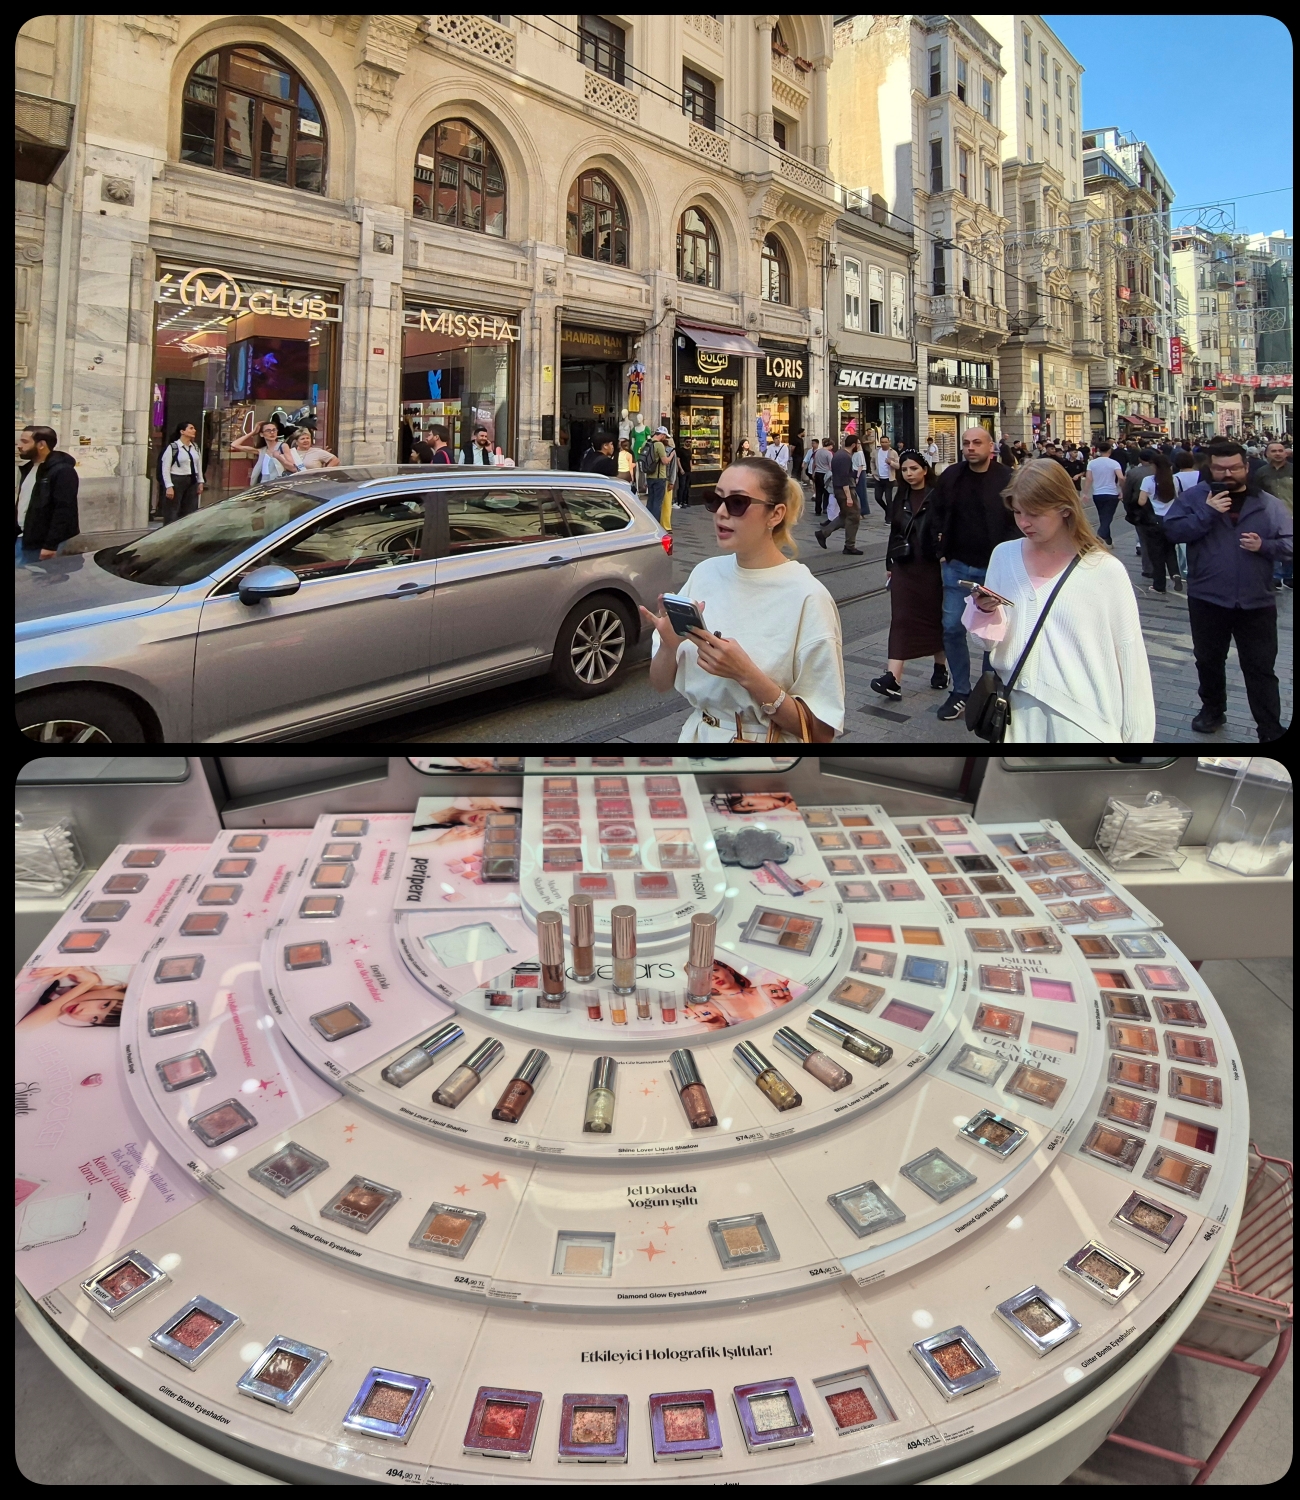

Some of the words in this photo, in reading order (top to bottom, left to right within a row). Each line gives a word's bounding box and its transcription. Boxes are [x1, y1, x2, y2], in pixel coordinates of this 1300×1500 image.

[249, 292, 327, 320] CLUB
[420, 308, 514, 342] MISSHA
[603, 336, 622, 348] HAN
[766, 356, 803, 379] LORIS
[684, 374, 709, 385] BEYOĞLU
[711, 376, 739, 387] ÇİKOLATASI
[774, 381, 796, 389] PARFUM
[839, 369, 918, 391] SKECHERS
[406, 857, 432, 902] peripera
[691, 873, 707, 900] MISSHA
[1001, 957, 1042, 966] IŞILTILI
[983, 1036, 1022, 1053] UZUN
[1025, 1048, 1061, 1065] SÜRE
[847, 1100, 860, 1108] Lover
[860, 1092, 873, 1103] Liquid
[873, 1081, 889, 1095] Shadow
[400, 1107, 413, 1115] Shine
[414, 1112, 428, 1121] Lover
[429, 1117, 446, 1127] Liquid
[446, 1123, 468, 1133] Shadow
[675, 1143, 699, 1151] Shadow
[78, 1161, 103, 1186] Yarat!
[92, 1155, 116, 1181] Kendi
[108, 1175, 136, 1204] Paletini
[627, 1186, 643, 1197] Jel
[645, 1184, 697, 1195] Dokuda
[628, 1198, 669, 1210] Yoğun
[672, 1196, 698, 1208] ışıltı
[955, 1217, 975, 1233] Diamond
[975, 1208, 986, 1220] Glow
[985, 1194, 1008, 1214] Eyeshadow
[290, 1224, 315, 1240] Diamond
[315, 1234, 330, 1246] Glow
[329, 1240, 362, 1258] Eyeshadow
[421, 1232, 460, 1247] crears
[1085, 1274, 1105, 1290] Tester
[93, 1287, 109, 1300] Tester
[669, 1290, 707, 1298] Eyeshadow
[581, 1348, 644, 1363] Etkileyici
[645, 1346, 720, 1362] Holografik
[722, 1345, 773, 1362] Işıltılar!
[1081, 1354, 1098, 1368] Glitter
[1096, 1345, 1112, 1358] Bomb
[1110, 1325, 1136, 1348] Eyeshadow
[159, 1385, 177, 1399] Glitter
[177, 1396, 195, 1409] Bomb
[194, 1404, 231, 1425] Eyeshadow
[907, 1438, 931, 1450] 494,90
[386, 1467, 414, 1481] 494,90
